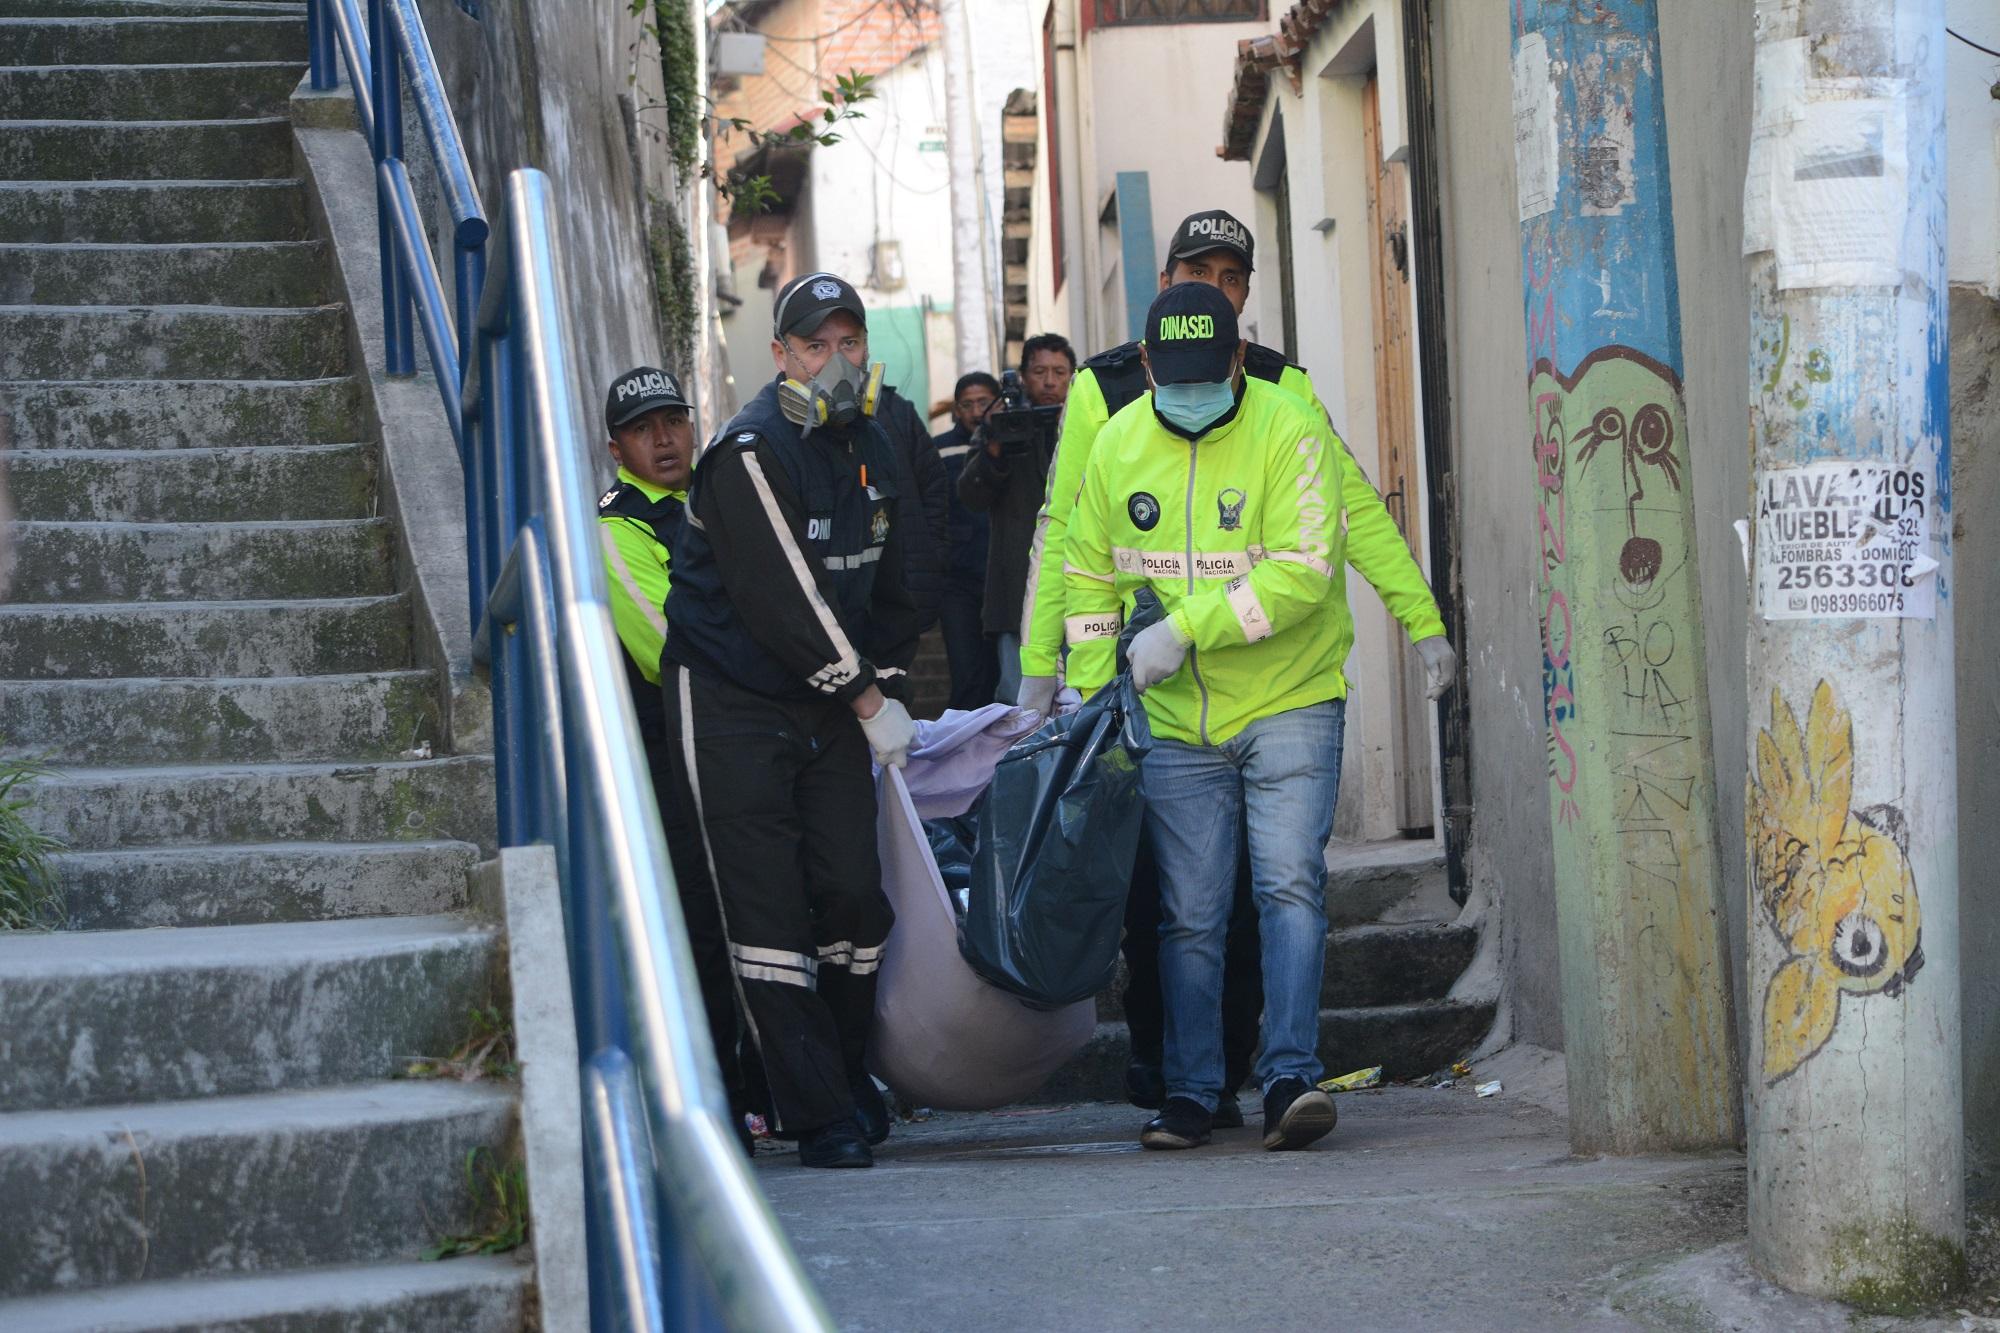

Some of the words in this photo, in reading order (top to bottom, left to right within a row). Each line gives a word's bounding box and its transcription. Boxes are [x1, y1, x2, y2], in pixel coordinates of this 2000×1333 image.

[1209, 234, 1248, 253] NACIONAL
[1160, 314, 1214, 340] DINASED
[640, 388, 679, 399] NACIONAL
[1204, 568, 1236, 576] NACIONAL
[1777, 562, 1915, 590] 2563308
[1810, 592, 1905, 614] 0983966075
